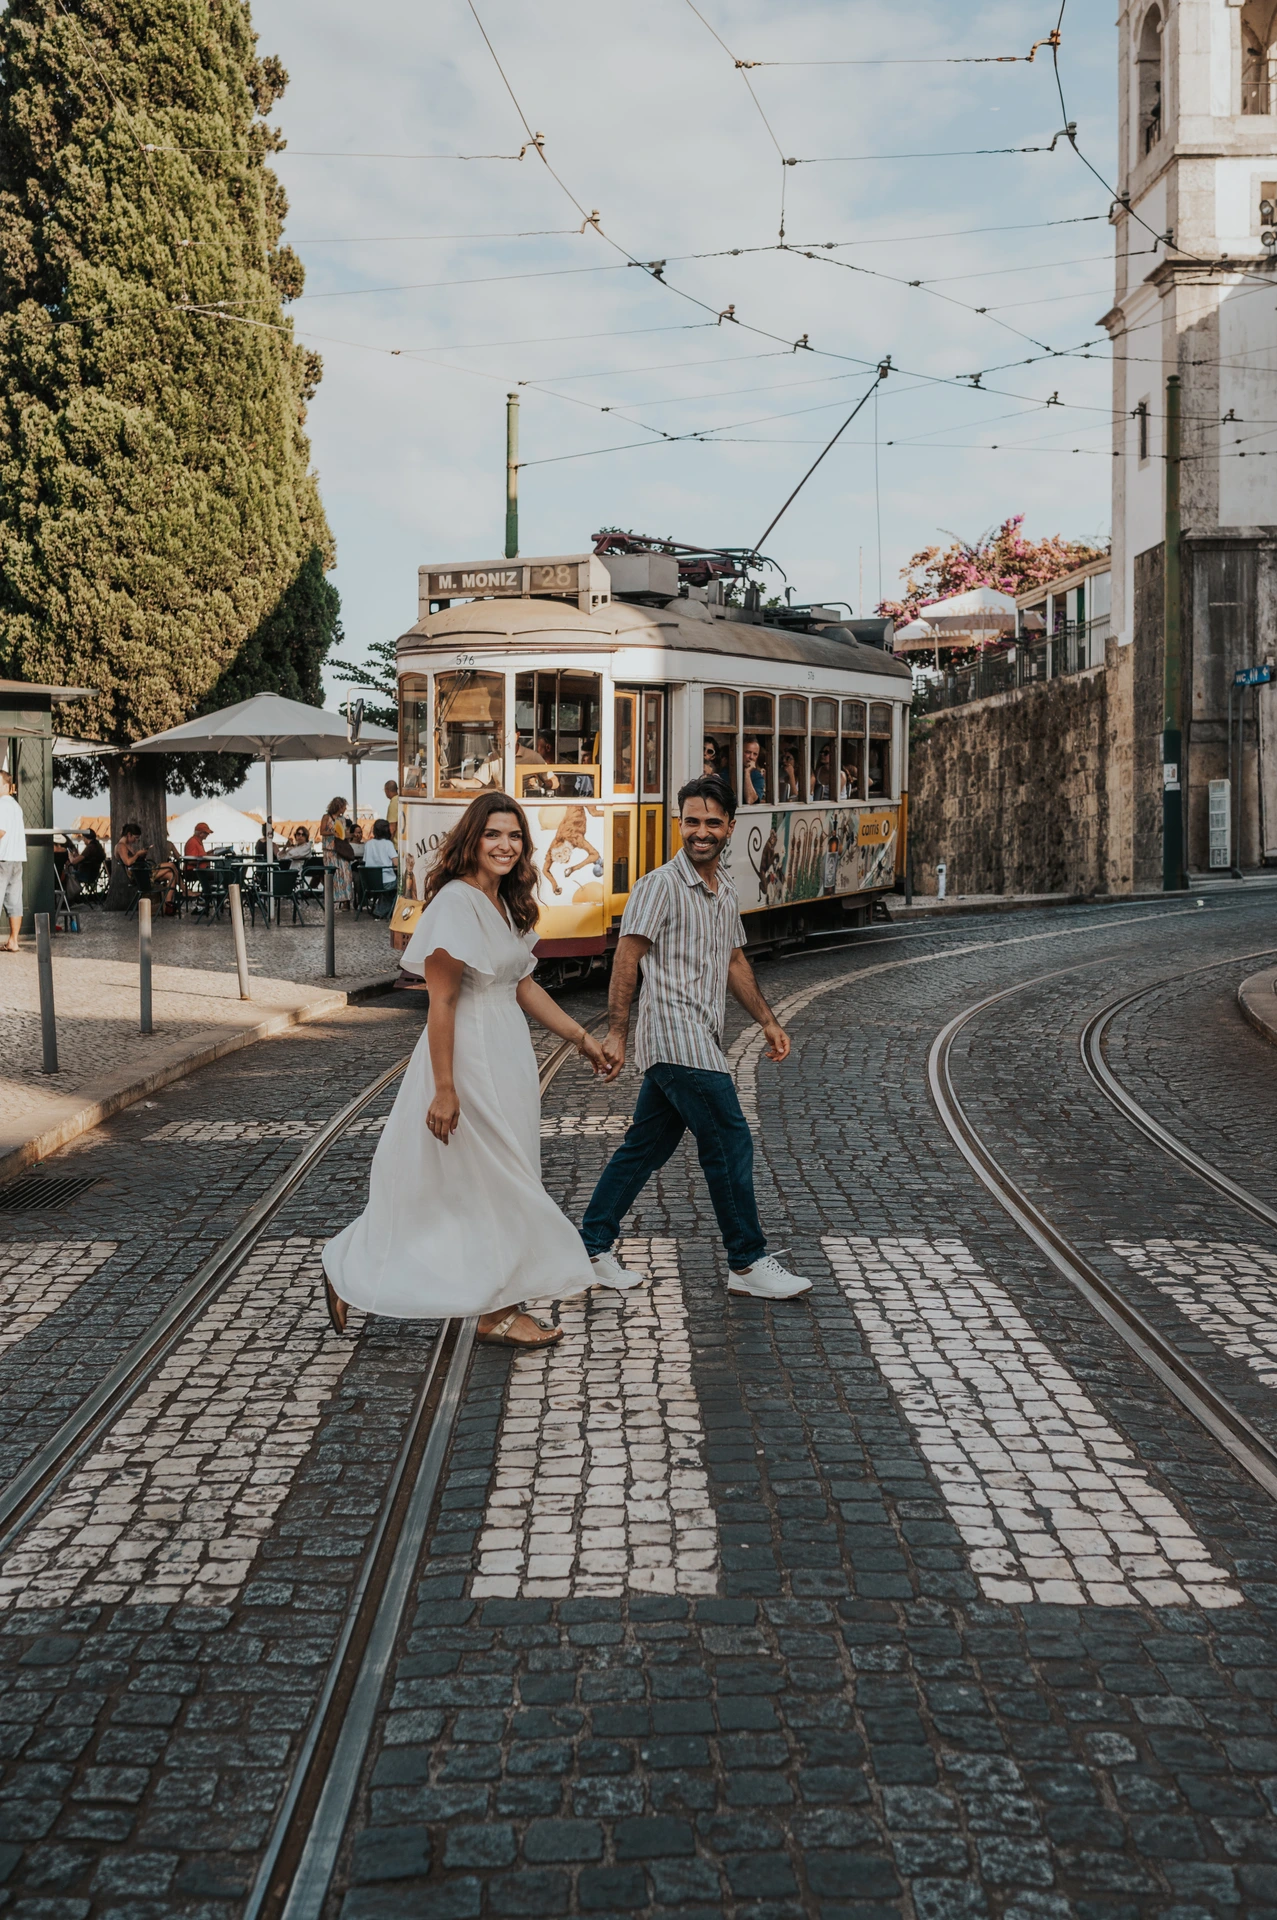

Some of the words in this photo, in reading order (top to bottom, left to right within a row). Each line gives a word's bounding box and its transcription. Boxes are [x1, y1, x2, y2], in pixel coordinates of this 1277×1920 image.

[438, 574, 457, 589] M.
[461, 571, 517, 588] MONIZ
[541, 565, 571, 587] 28
[456, 654, 475, 666] 576
[1235, 673, 1246, 683] WC
[861, 819, 880, 837] carris
